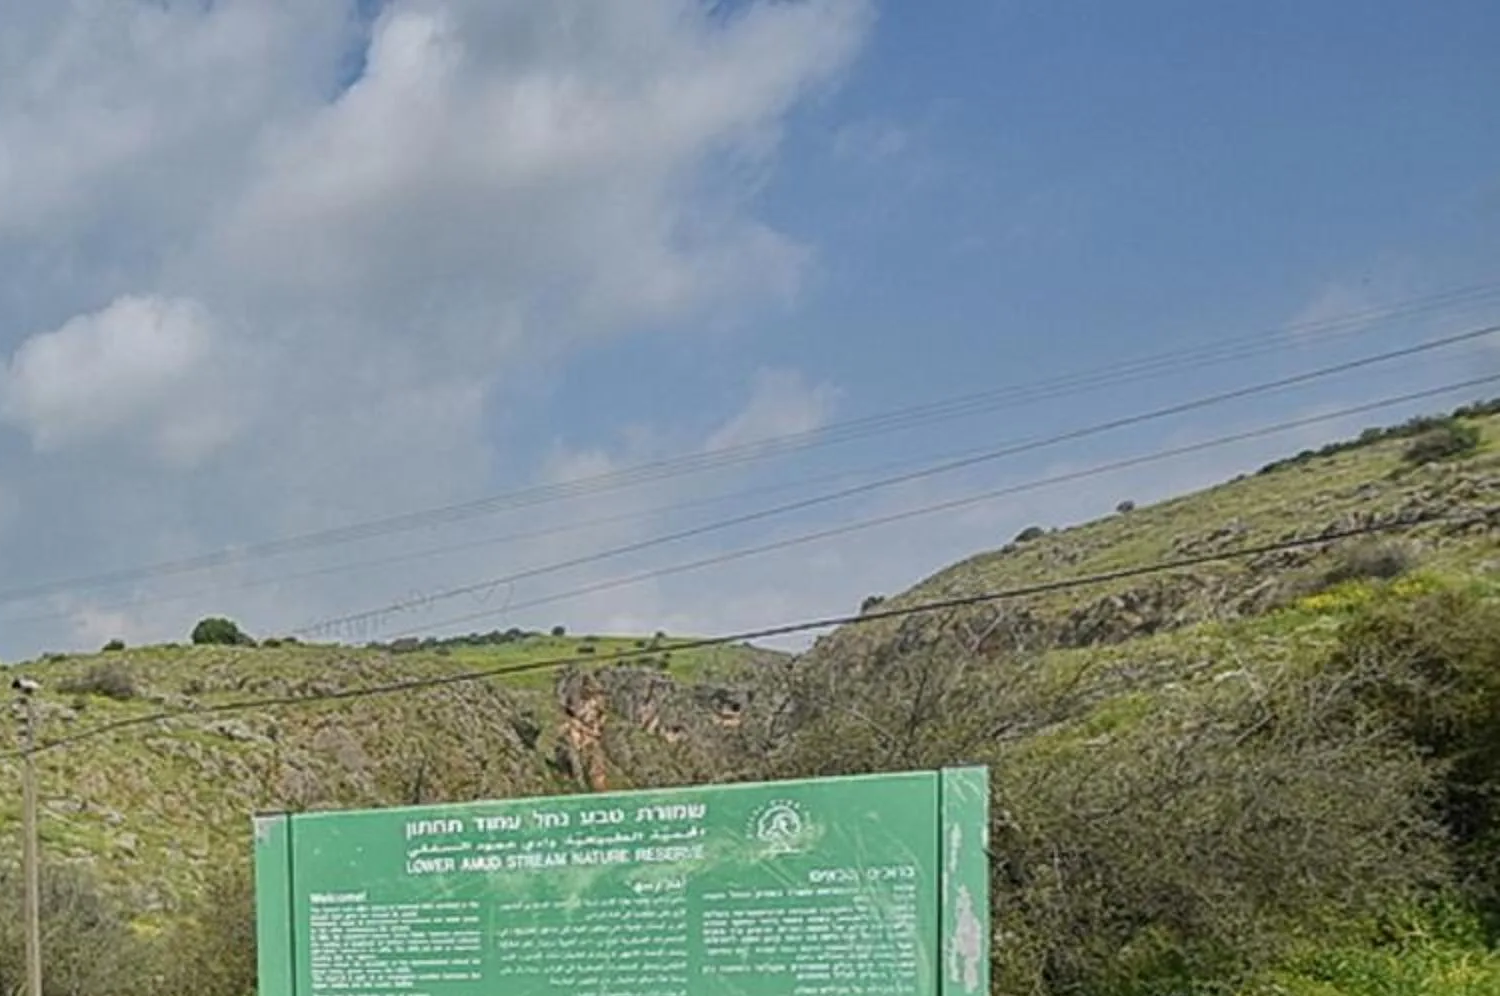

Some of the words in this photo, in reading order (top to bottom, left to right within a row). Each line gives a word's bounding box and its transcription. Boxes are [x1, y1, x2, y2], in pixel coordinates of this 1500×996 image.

[472, 814, 522, 833] עמוד
[532, 809, 570, 828] נחל
[580, 807, 625, 826] טבע
[635, 803, 706, 824] שמורת
[405, 818, 464, 841] תחתון
[405, 856, 456, 875] LOWER
[460, 854, 503, 872] AMUD
[506, 851, 567, 869] STREAM
[570, 847, 632, 866] NATURE
[635, 843, 705, 863] RESERVE
